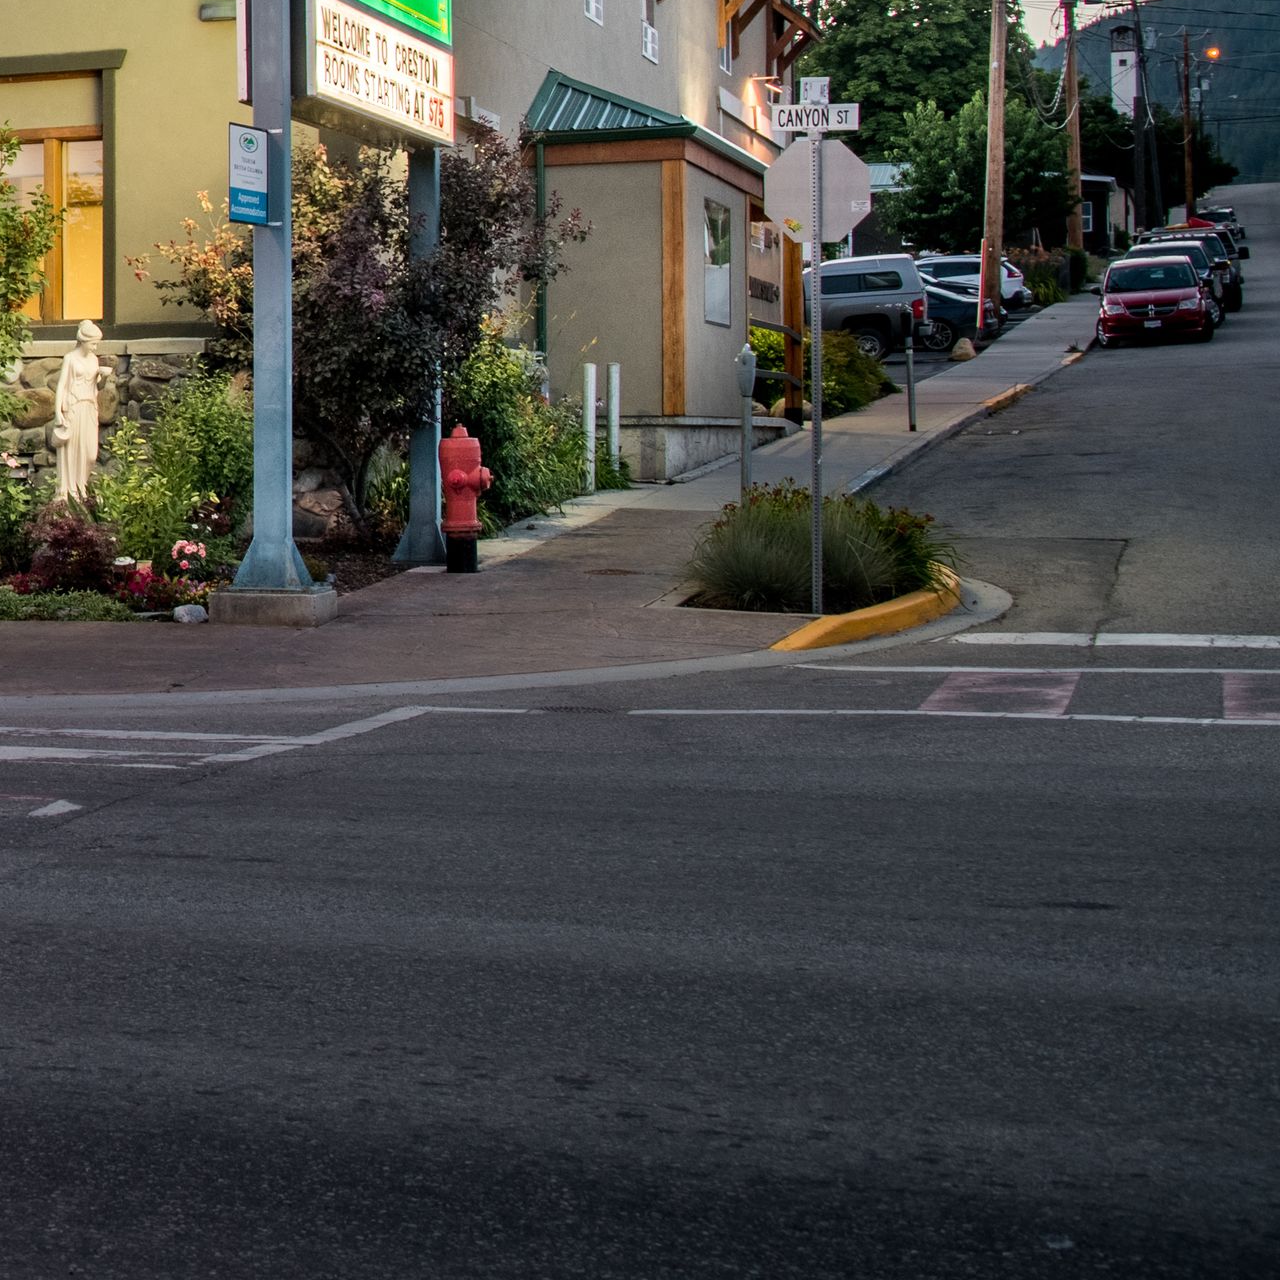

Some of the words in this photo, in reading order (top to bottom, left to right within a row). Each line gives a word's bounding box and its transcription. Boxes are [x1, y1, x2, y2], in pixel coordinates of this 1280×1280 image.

[321, 6, 370, 58] WELCOME
[375, 32, 388, 66] TO
[395, 42, 438, 88] CRESTON
[324, 50, 359, 95] ROOMS
[364, 68, 410, 115] STARTING
[413, 89, 425, 121] AT
[428, 96, 444, 129] $75
[778, 108, 829, 128] CANYON
[836, 109, 850, 125] ST
